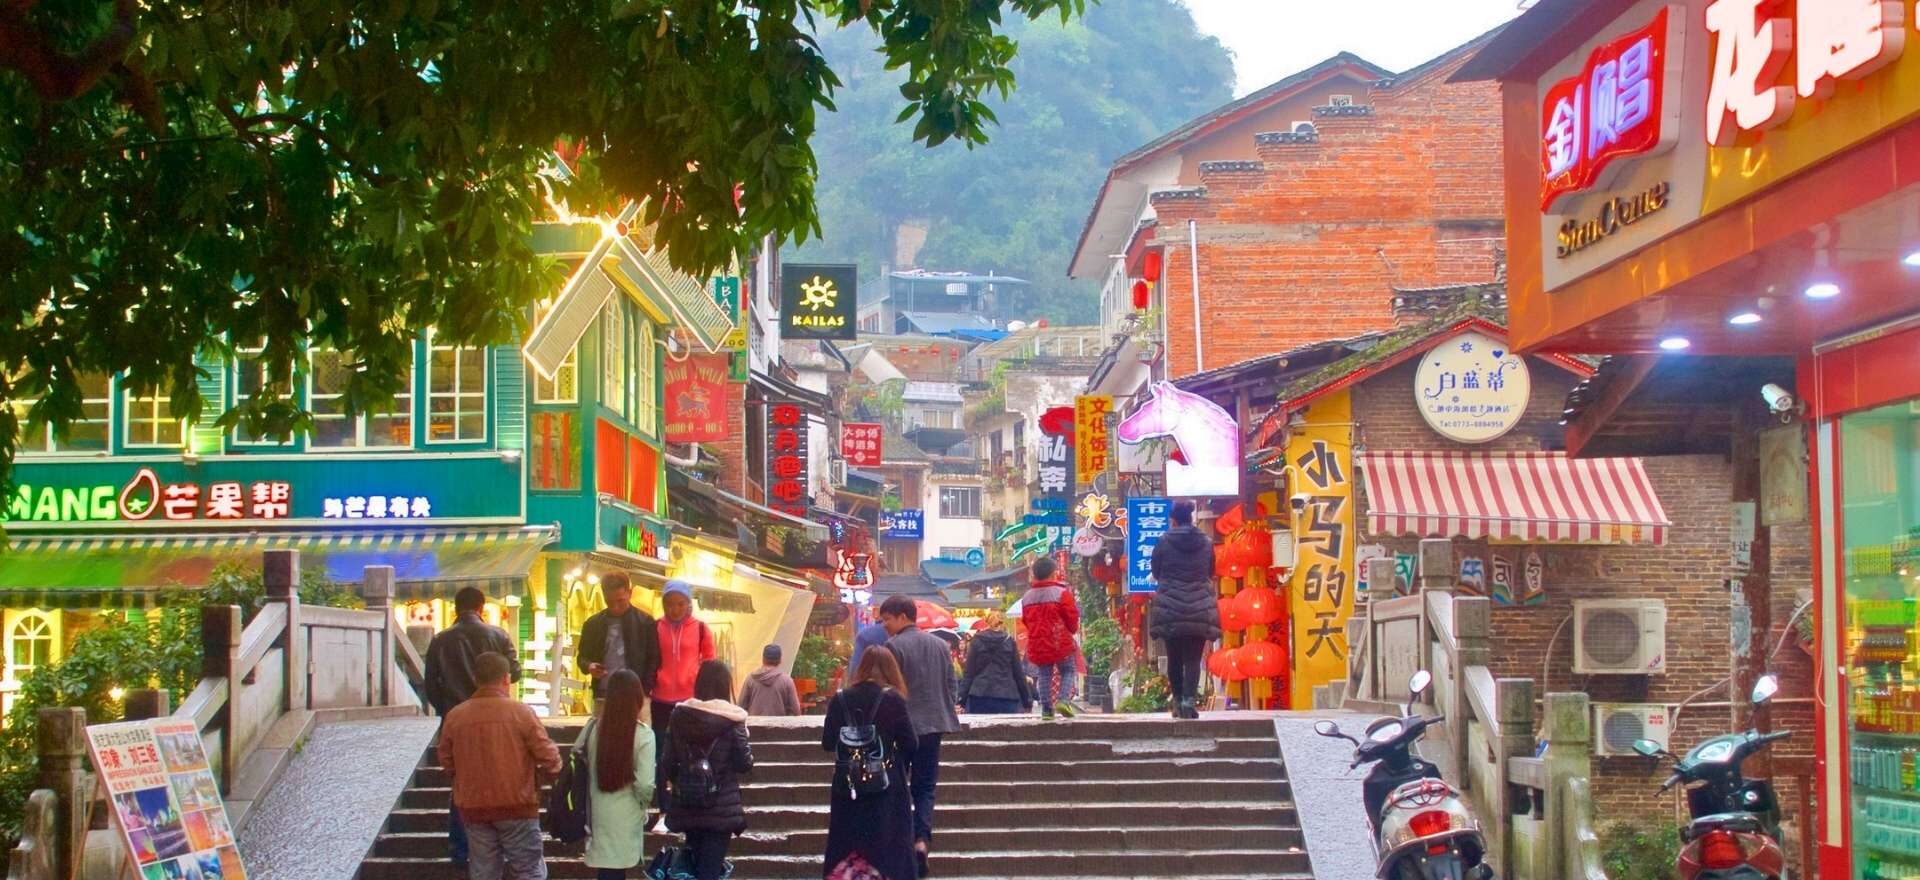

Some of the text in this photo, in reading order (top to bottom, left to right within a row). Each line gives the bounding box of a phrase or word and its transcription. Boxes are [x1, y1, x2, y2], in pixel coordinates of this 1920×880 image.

[792, 315, 845, 326] KAILAS
[1039, 434, 1066, 492] 私奔
[163, 482, 290, 519] 芒果帮
[1297, 439, 1345, 661] 小马的天
